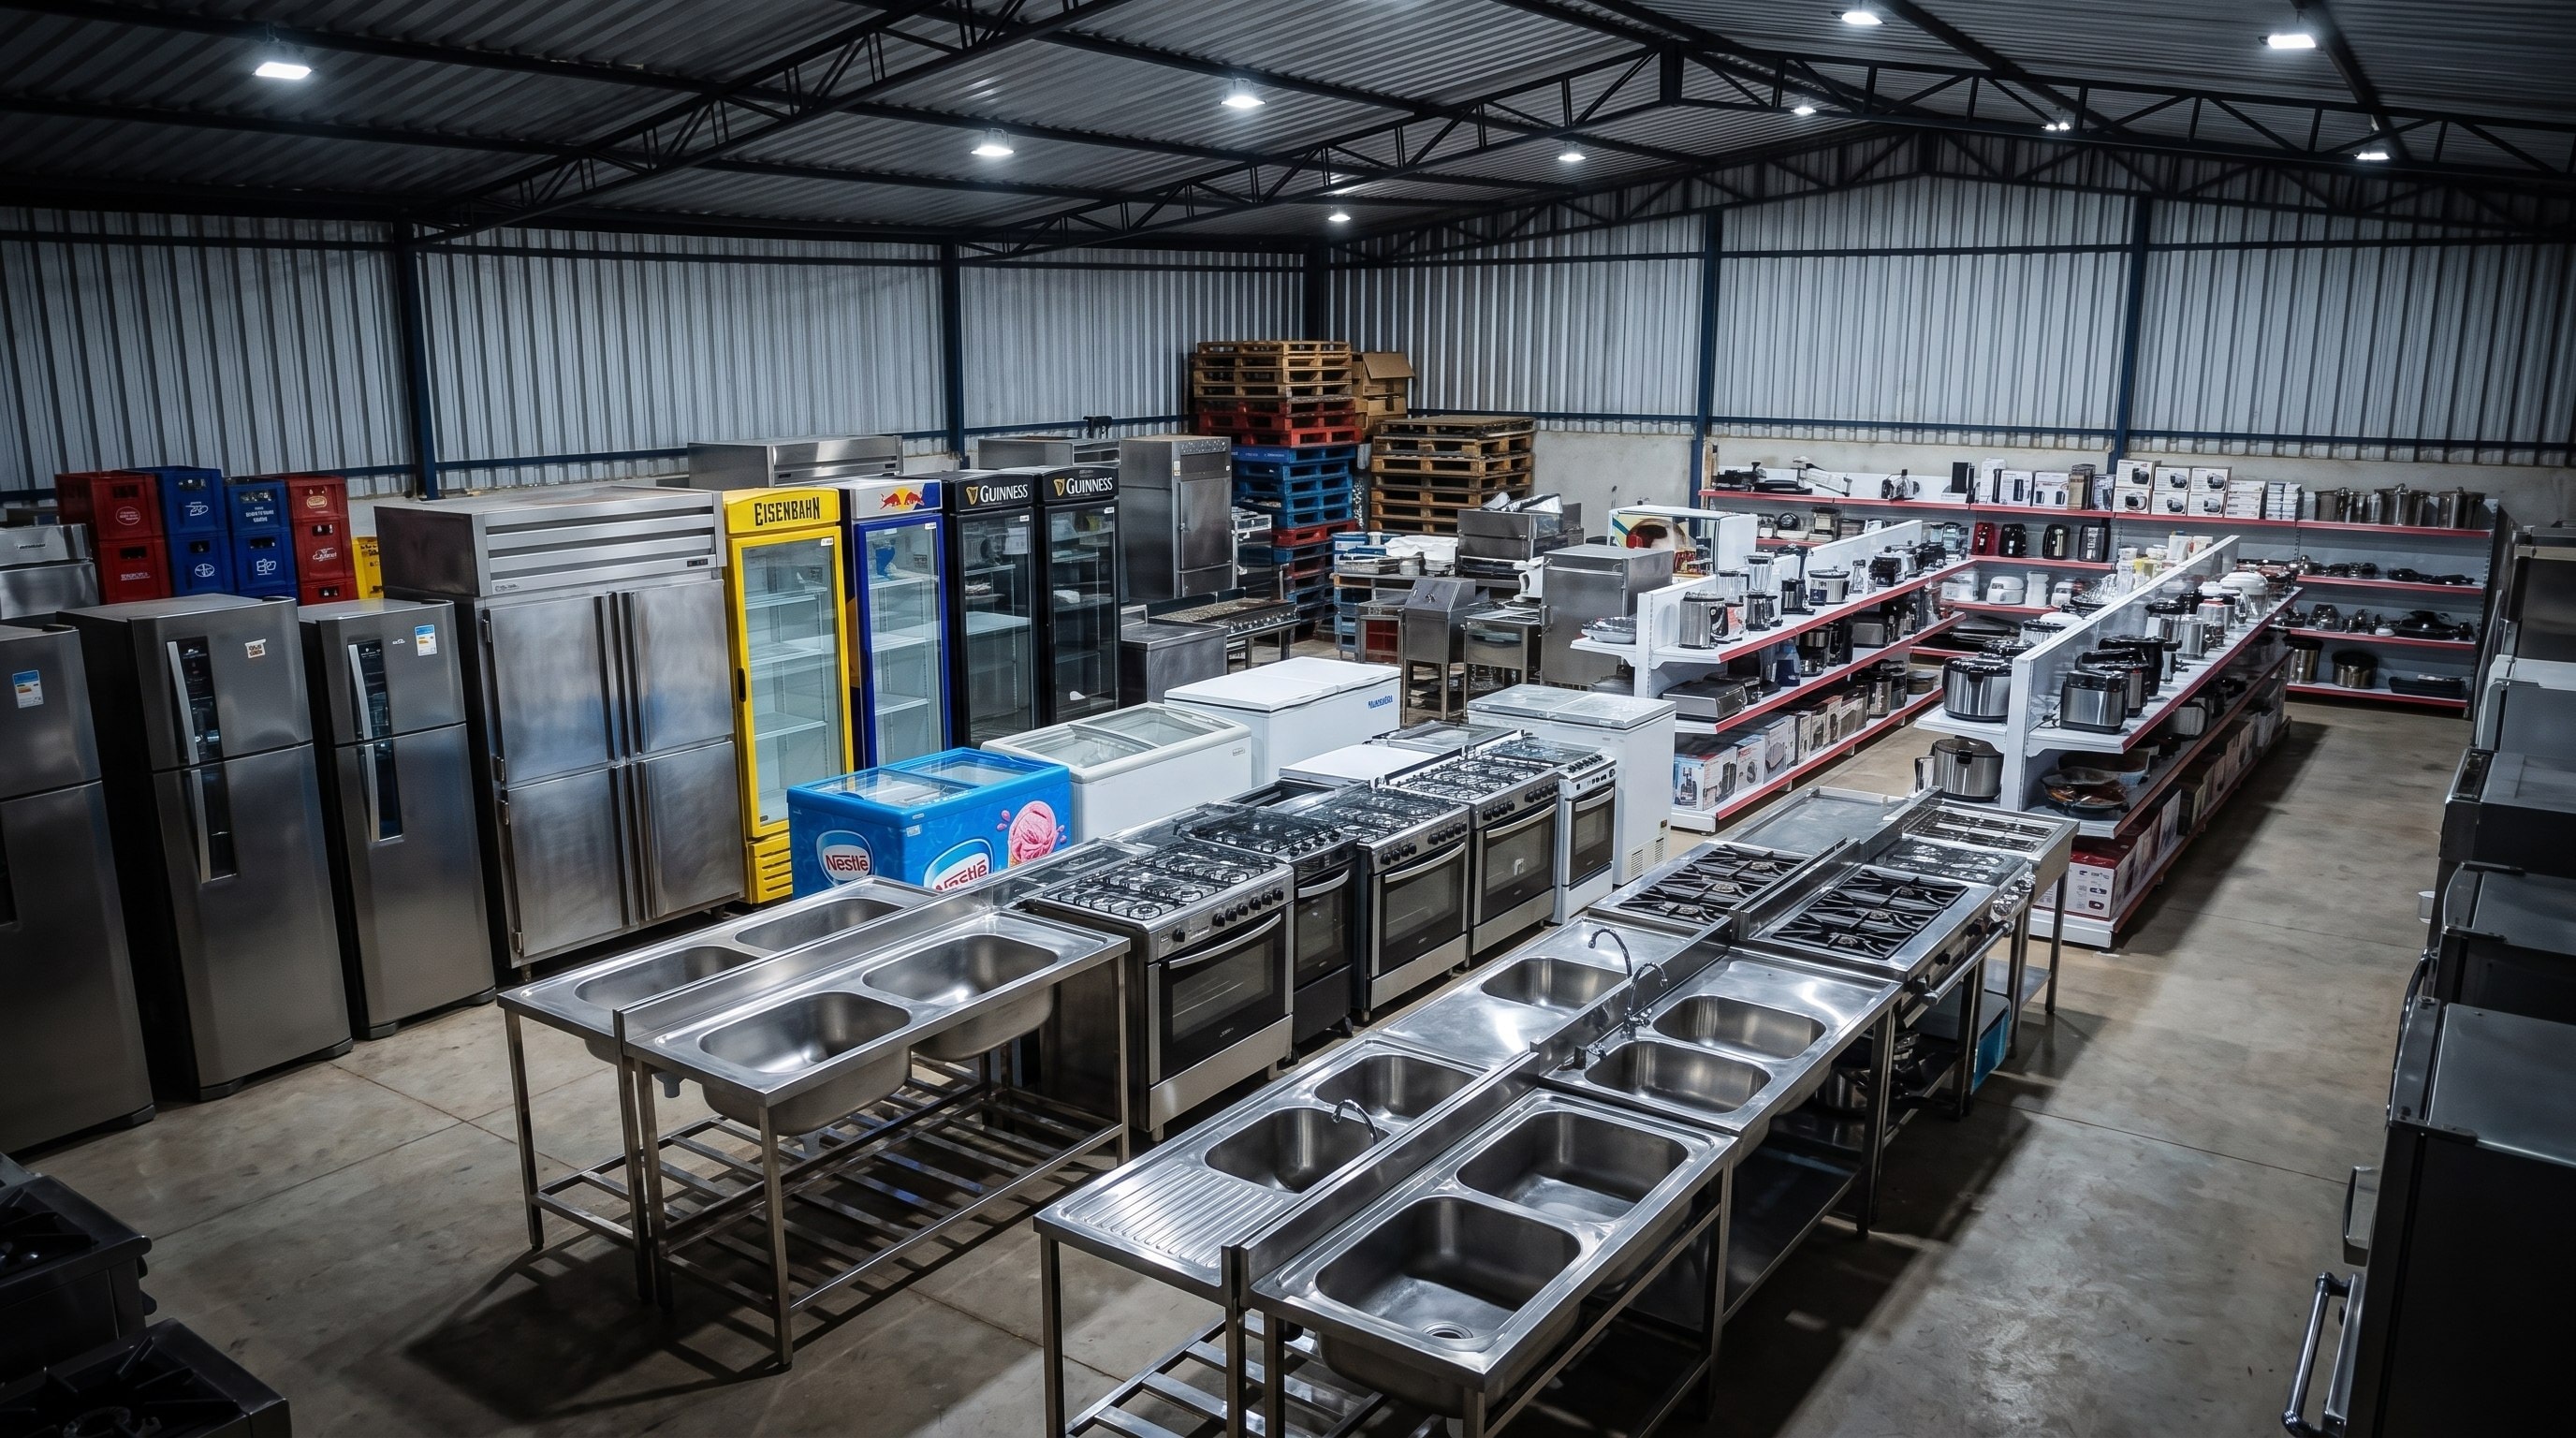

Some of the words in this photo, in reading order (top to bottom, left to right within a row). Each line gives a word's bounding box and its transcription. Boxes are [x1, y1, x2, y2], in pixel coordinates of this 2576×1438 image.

[979, 483, 1029, 503] GUINNESS
[1066, 477, 1113, 493] GUINNESS
[754, 496, 821, 526] EISENBAHN
[825, 854, 869, 872] Nestlé
